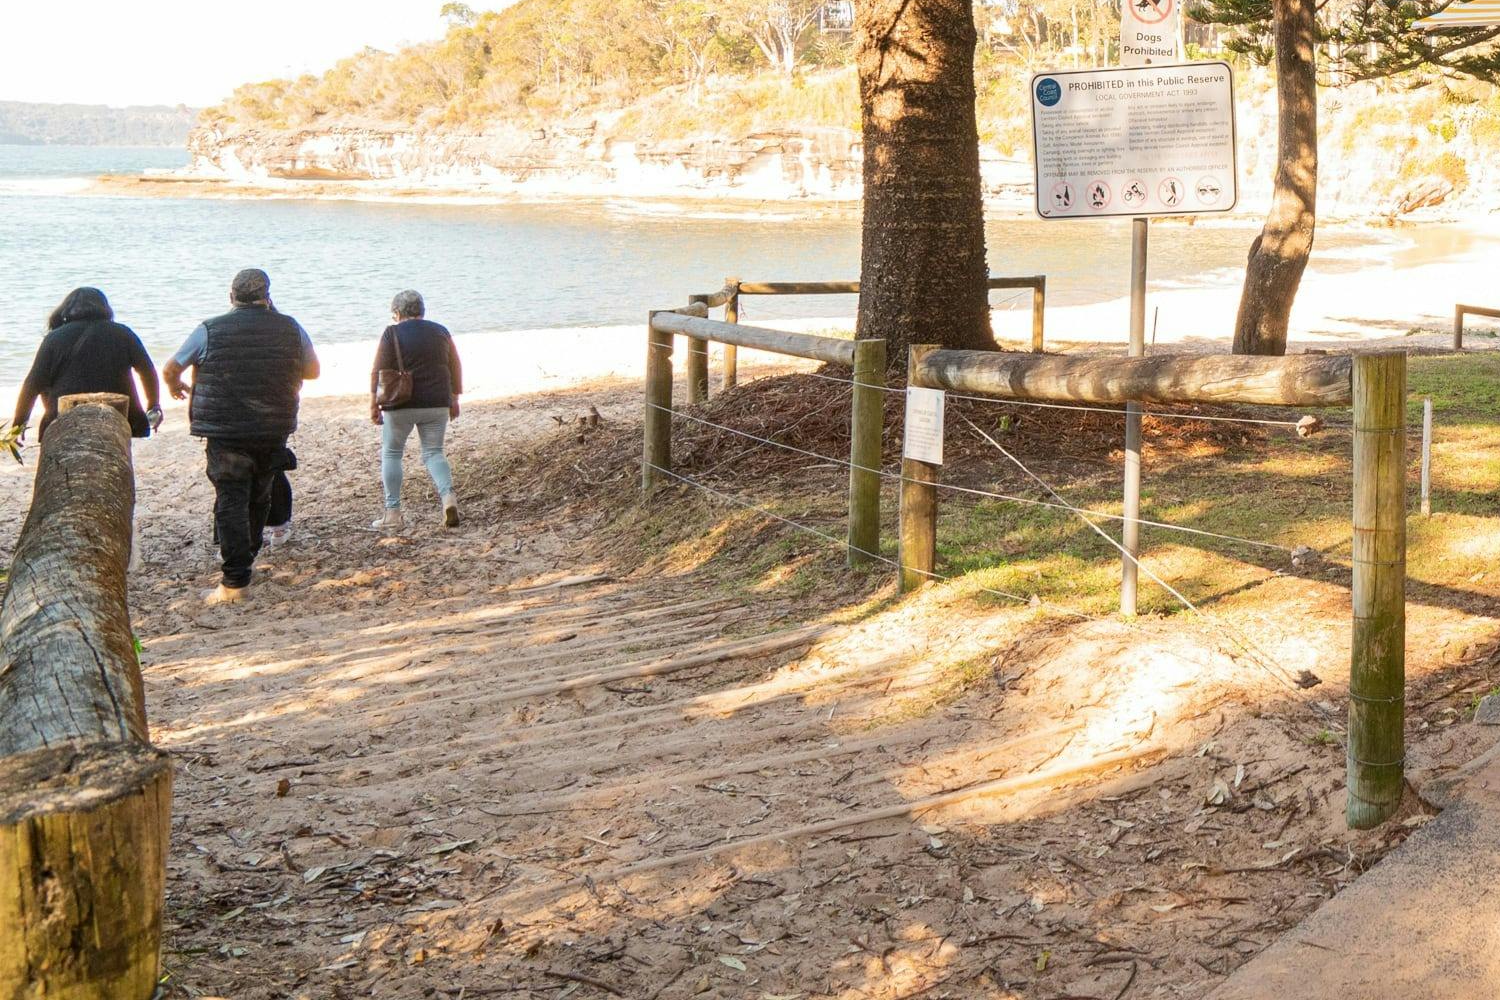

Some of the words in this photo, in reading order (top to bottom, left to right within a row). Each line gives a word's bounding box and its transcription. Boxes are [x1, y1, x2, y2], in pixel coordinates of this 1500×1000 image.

[1136, 32, 1162, 43] Dogs
[1123, 45, 1173, 57] Prohibited
[1068, 79, 1124, 91] PROHIBITED
[1126, 79, 1135, 88] in
[1137, 78, 1154, 87] this
[1157, 76, 1185, 86] Public
[1187, 75, 1225, 84] Reserve
[1095, 93, 1116, 101] LOCAL
[1118, 90, 1164, 100] GOVERNMENT
[1166, 89, 1180, 97] ACT
